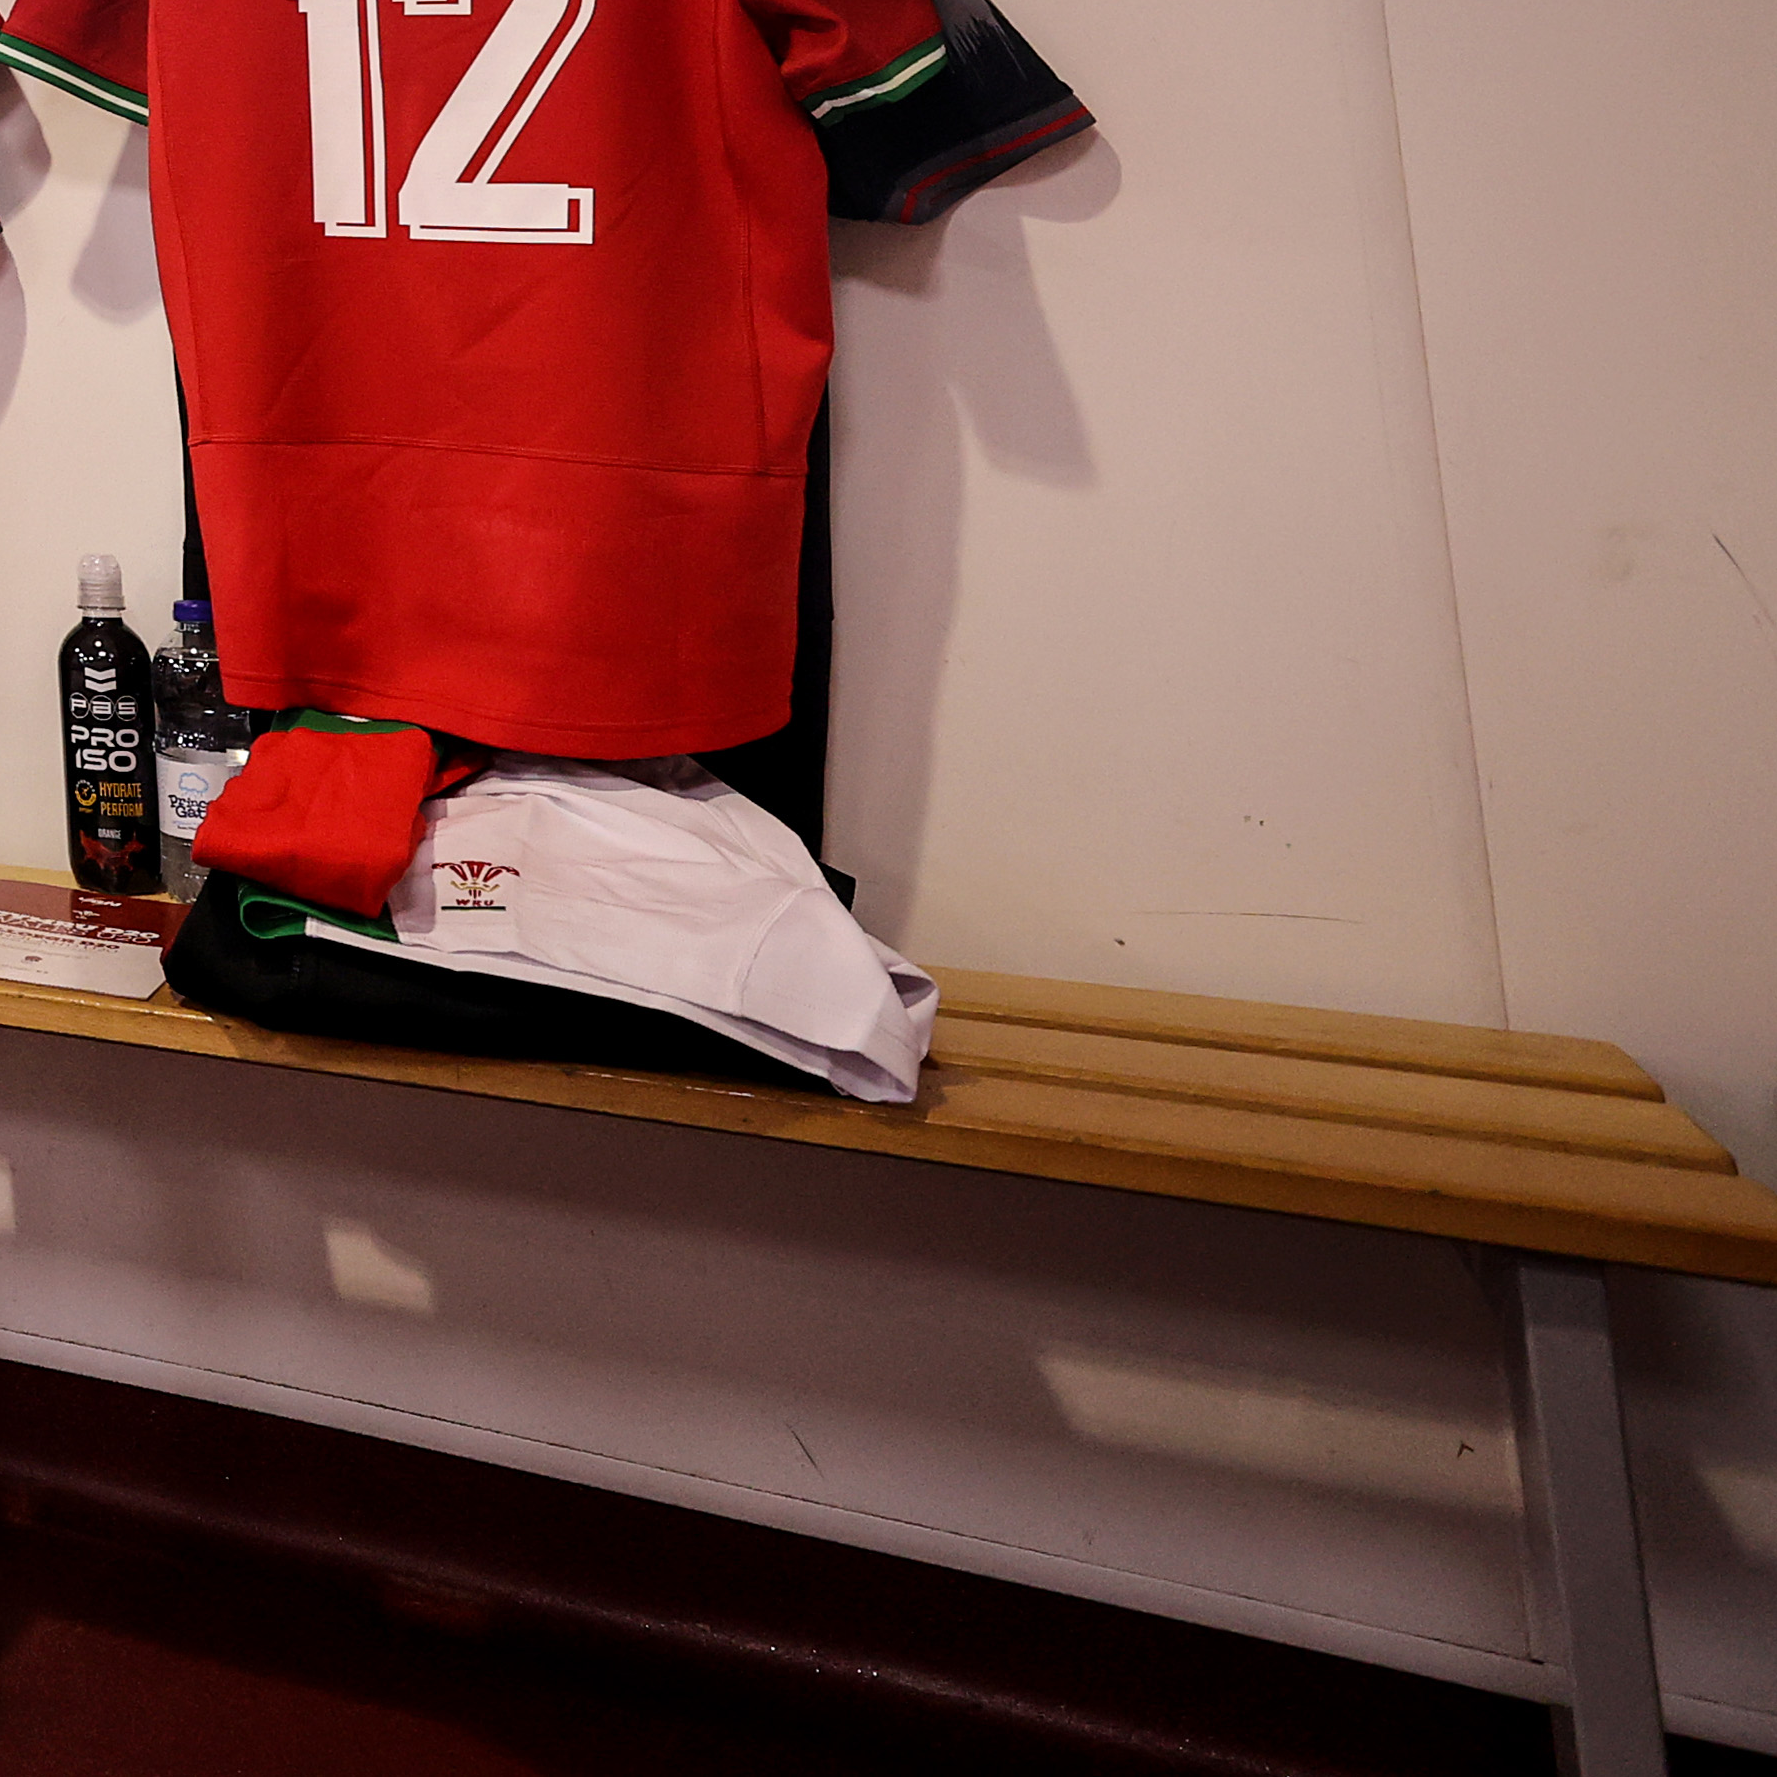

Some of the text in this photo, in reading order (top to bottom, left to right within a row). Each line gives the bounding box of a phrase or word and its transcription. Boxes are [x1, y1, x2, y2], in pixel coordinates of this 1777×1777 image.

[71, 724, 139, 748] PRO
[75, 748, 137, 772] ISO
[99, 781, 142, 799] HYDRATE
[100, 801, 144, 817] PERFORM
[168, 794, 208, 809] Princ
[176, 805, 207, 820] Gat
